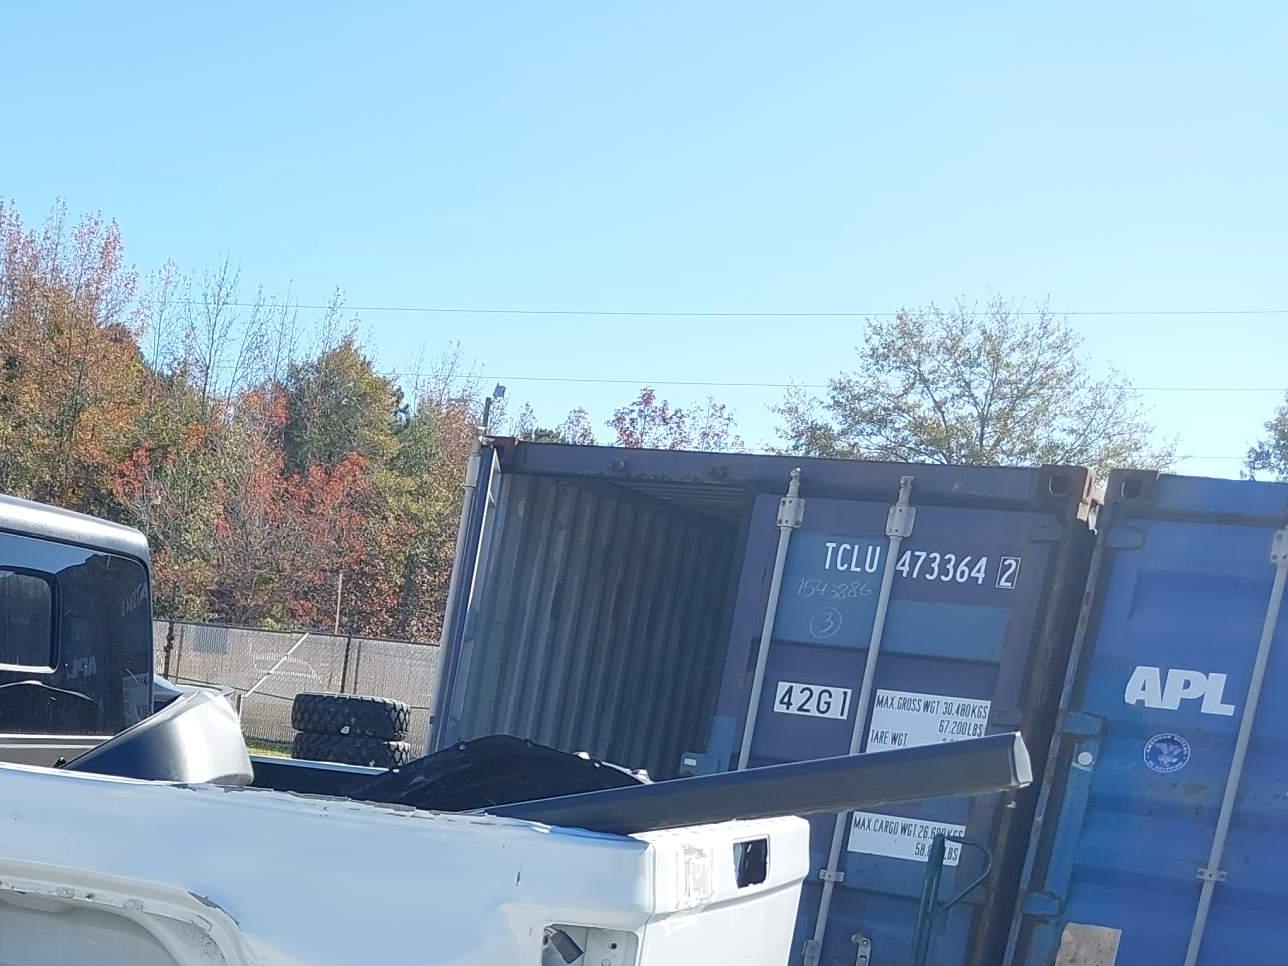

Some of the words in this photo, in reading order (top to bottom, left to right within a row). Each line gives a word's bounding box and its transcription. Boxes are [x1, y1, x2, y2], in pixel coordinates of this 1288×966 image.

[824, 542, 881, 573] TCLU
[896, 550, 988, 585] 473364
[999, 559, 1016, 587] 2
[779, 685, 848, 717] 42G1
[1124, 666, 1235, 716] APL
[897, 697, 922, 712] GROSS
[871, 729, 889, 744] TARE
[873, 821, 899, 834] CARGO
